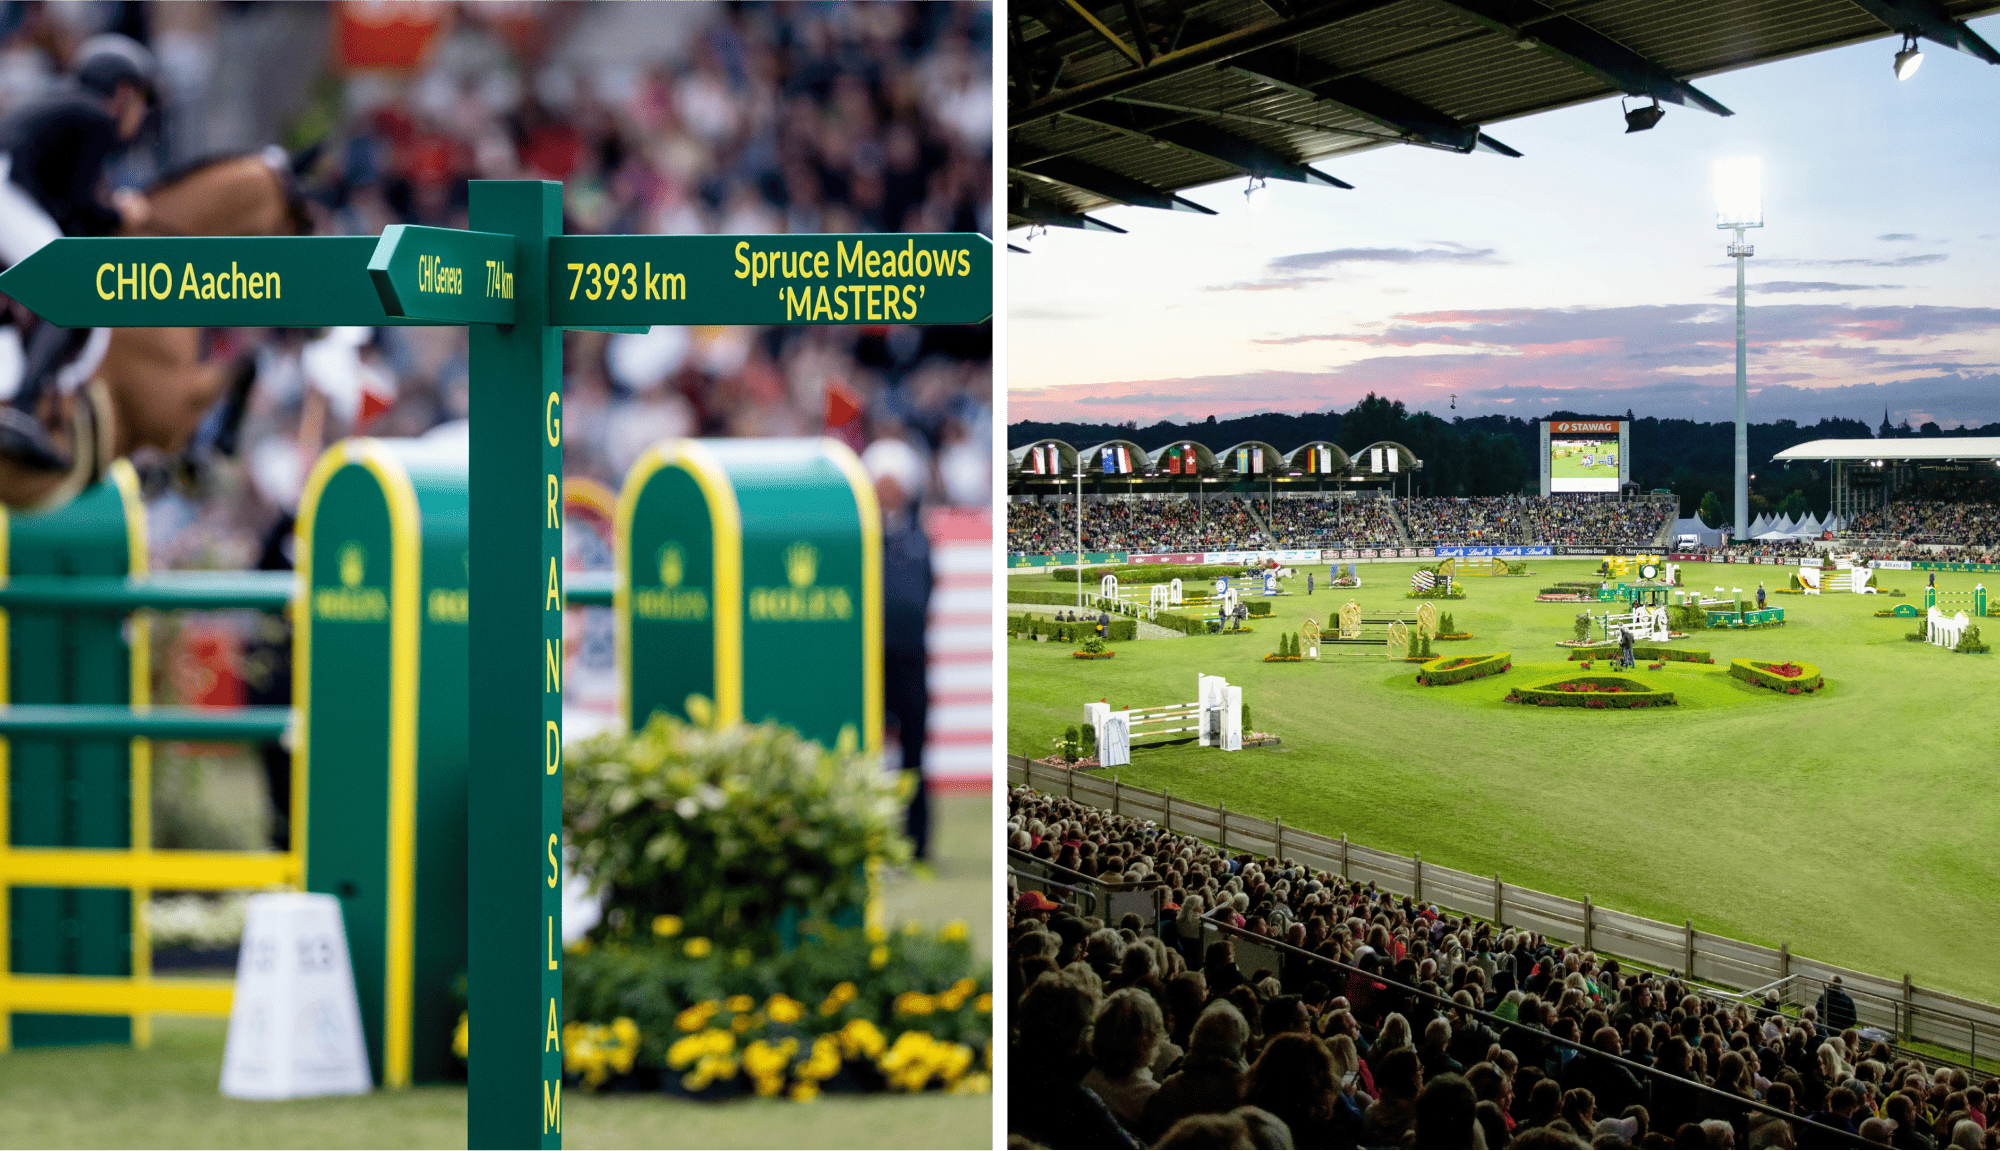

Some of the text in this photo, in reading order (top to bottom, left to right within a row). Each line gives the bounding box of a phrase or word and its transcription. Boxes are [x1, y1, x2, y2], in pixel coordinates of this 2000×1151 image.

[96, 261, 281, 301] CHIO Aachen
[418, 254, 514, 299] CHI Geneva 774 km
[567, 261, 686, 301] 7393 km
[734, 238, 971, 287] Spruce Meadows
[1571, 423, 1612, 431] STAWAG
[1438, 548, 1460, 556] Lindt
[1467, 547, 1489, 556] Lindt
[1496, 547, 1518, 556] Lindt
[1525, 547, 1546, 556] Lindt
[545, 391, 561, 776] GRAND
[748, 585, 854, 622] ROLEX
[544, 832, 561, 1134] SLAM
